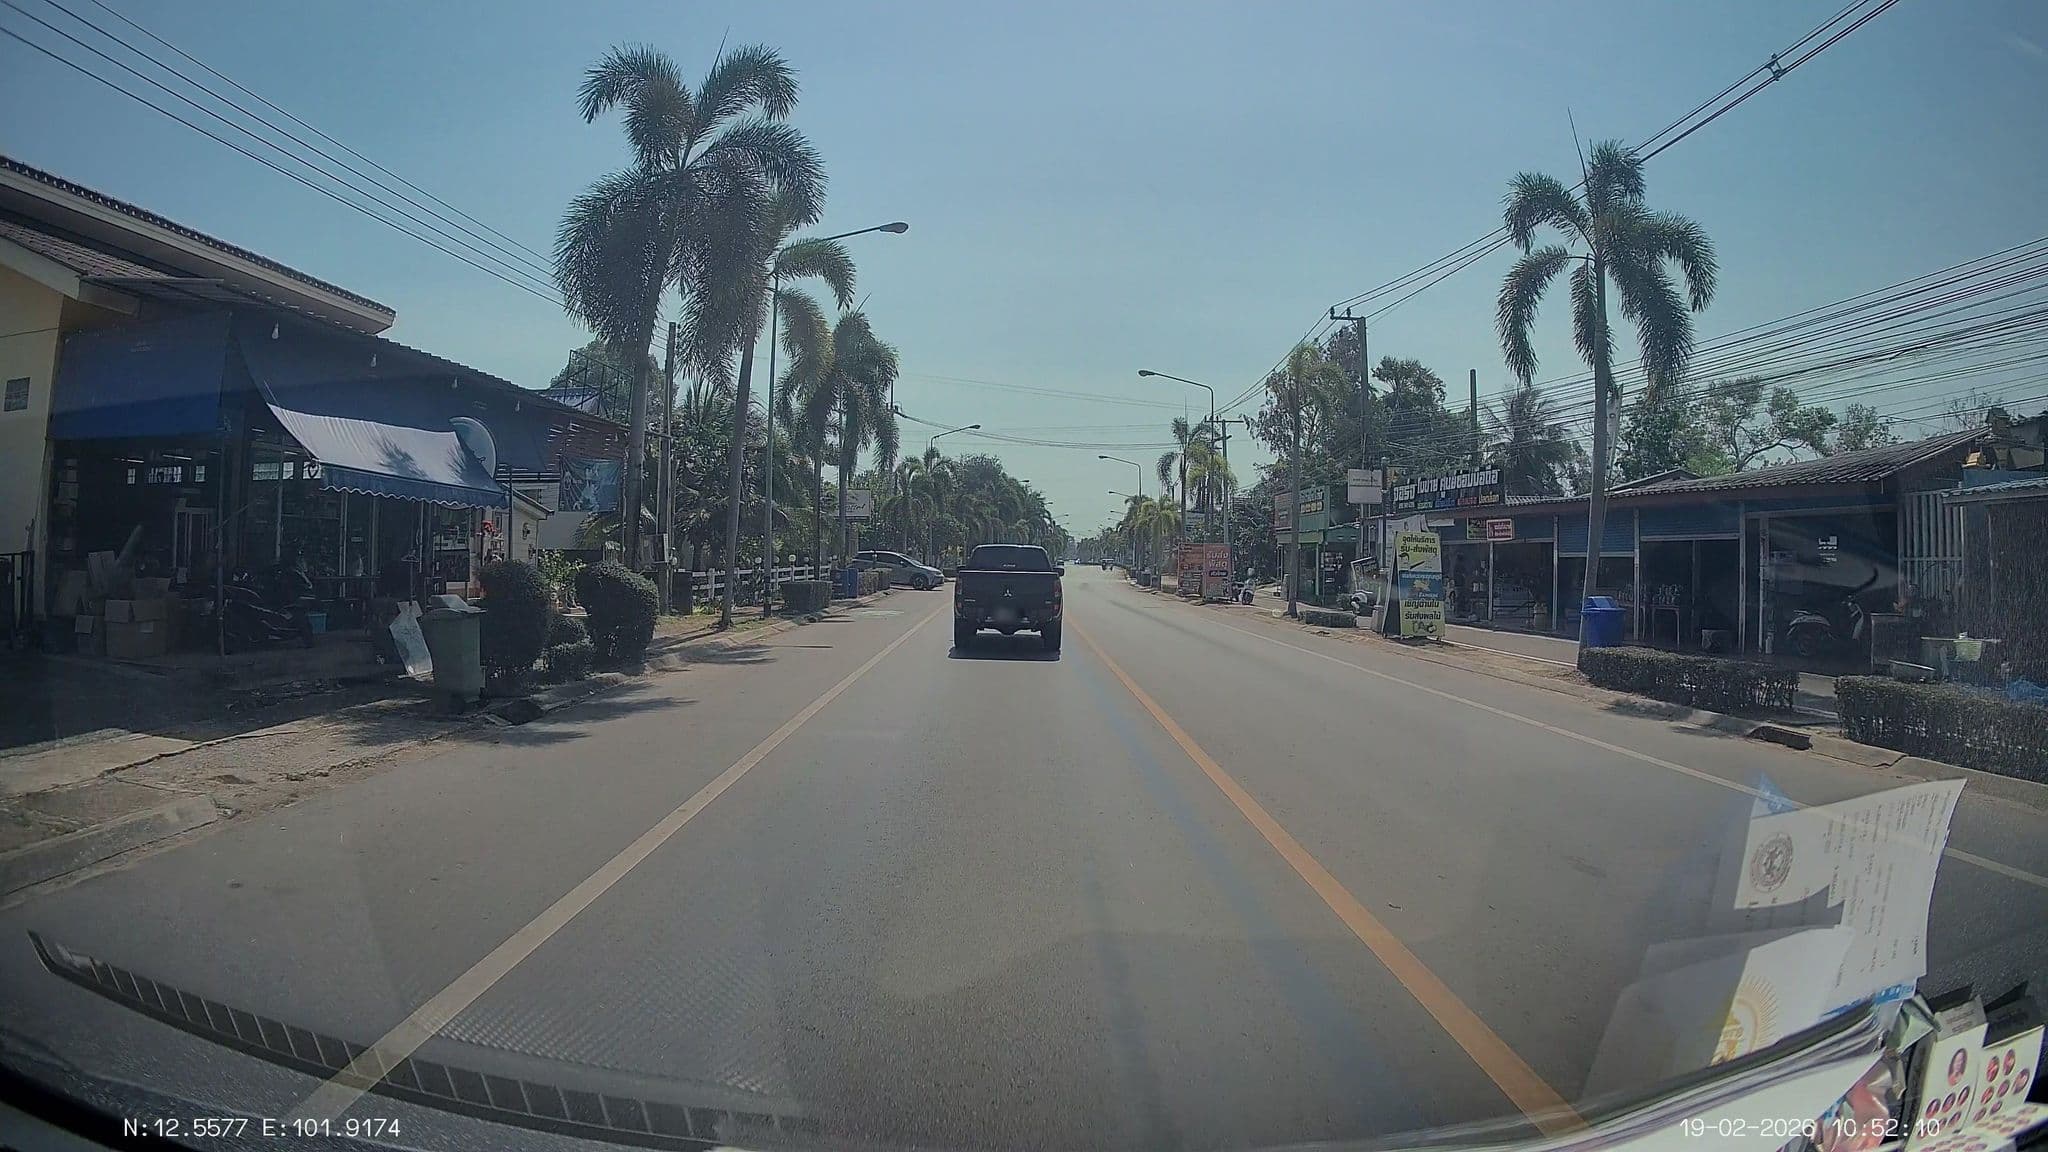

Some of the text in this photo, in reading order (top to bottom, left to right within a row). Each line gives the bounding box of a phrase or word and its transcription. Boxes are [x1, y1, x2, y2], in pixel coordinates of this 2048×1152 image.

[1400, 543, 1438, 556] รับ-ส่งพัสดุ
